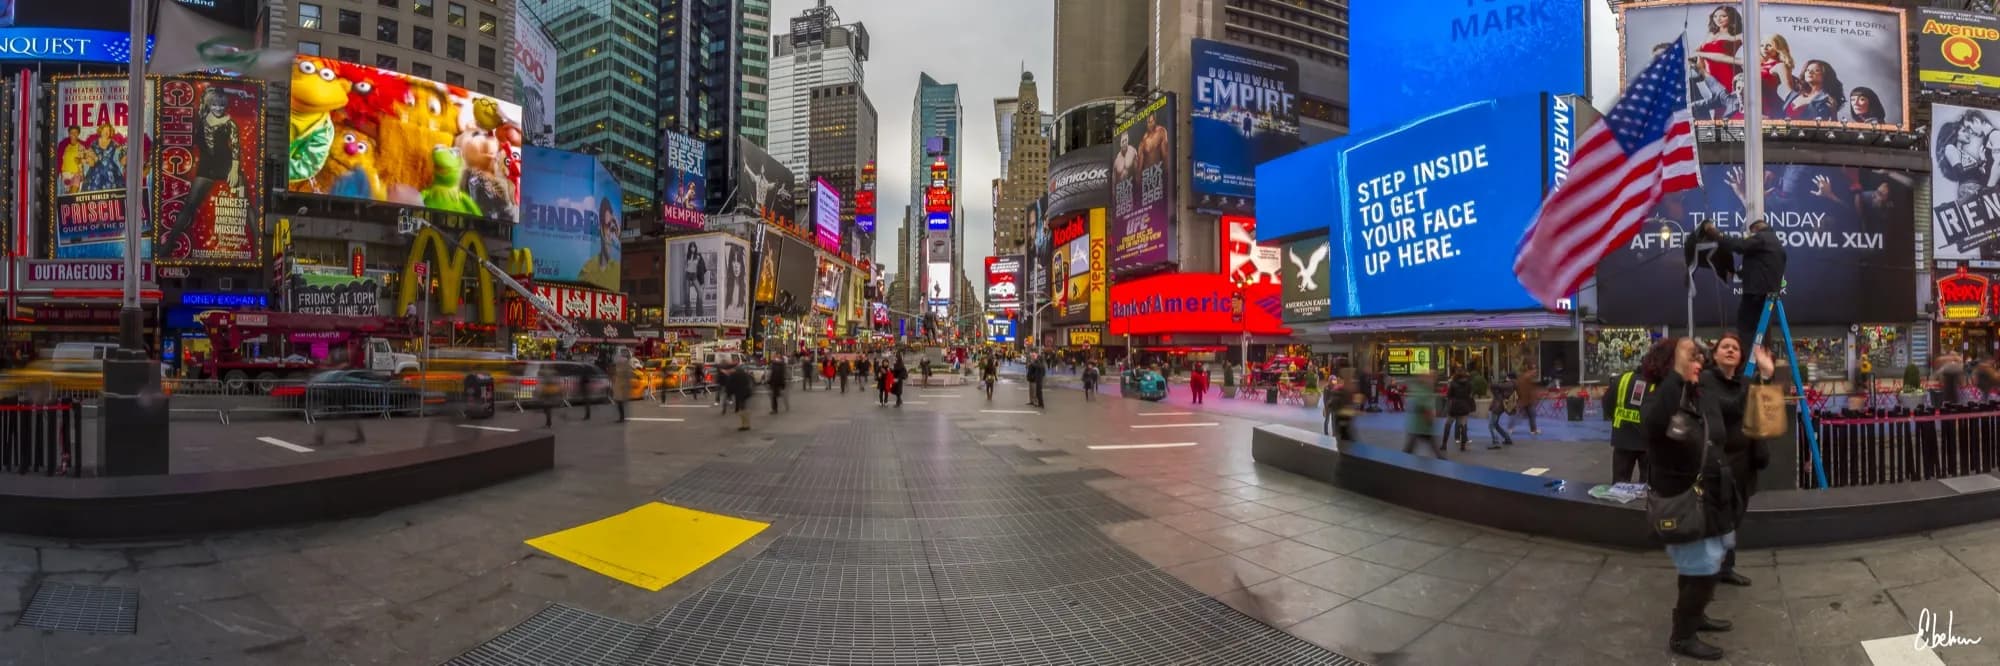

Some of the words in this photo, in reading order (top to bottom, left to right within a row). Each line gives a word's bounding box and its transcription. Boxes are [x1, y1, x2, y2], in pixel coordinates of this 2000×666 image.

[1452, 0, 1549, 42] MARK
[1792, 25, 1837, 34] THEY'RE
[1813, 18, 1851, 27] AREN'T
[1922, 19, 2000, 40] Avenue
[1941, 35, 1981, 71] Q
[1208, 67, 1284, 91] BOARDWALK
[1197, 75, 1295, 114] EMPIRE
[64, 102, 128, 128] HEAR
[667, 129, 705, 151] WINNER!
[1553, 94, 1569, 192] AMERIC
[668, 160, 704, 177] MUSICAL
[669, 146, 704, 169] BEST
[1357, 170, 1406, 204] STEP
[1414, 144, 1489, 186] INSIDE
[60, 198, 146, 226] PRISCIL
[214, 206, 248, 218] RUNNING
[664, 205, 705, 227] MEMPHIS
[1360, 202, 1384, 227] TO
[1391, 187, 1428, 217] GET
[214, 215, 247, 226] AMERICAN
[214, 224, 246, 236] MUSICAL
[1362, 217, 1416, 250] YOUR
[1424, 200, 1478, 235] FACE
[1689, 211, 1729, 228] THE
[1735, 210, 1826, 229] MNDAY
[1053, 216, 1085, 248] Kodak
[1775, 230, 1838, 248] BOWL
[1841, 231, 1884, 249] XLVI
[1091, 238, 1105, 292] Kodak
[1364, 251, 1391, 277] UP
[1398, 233, 1461, 268] HERE.
[34, 263, 112, 281] OUTRAGEOUS
[118, 264, 146, 280] F!
[183, 295, 215, 305] MONEY
[298, 293, 336, 305] FRIDAYS
[339, 293, 349, 305] AT
[352, 291, 375, 304] 10PM
[1113, 300, 1139, 318] Bank
[1140, 296, 1153, 314] of
[1153, 292, 1245, 313] Americ
[298, 306, 332, 315] STARTS
[337, 305, 358, 316] JUNE
